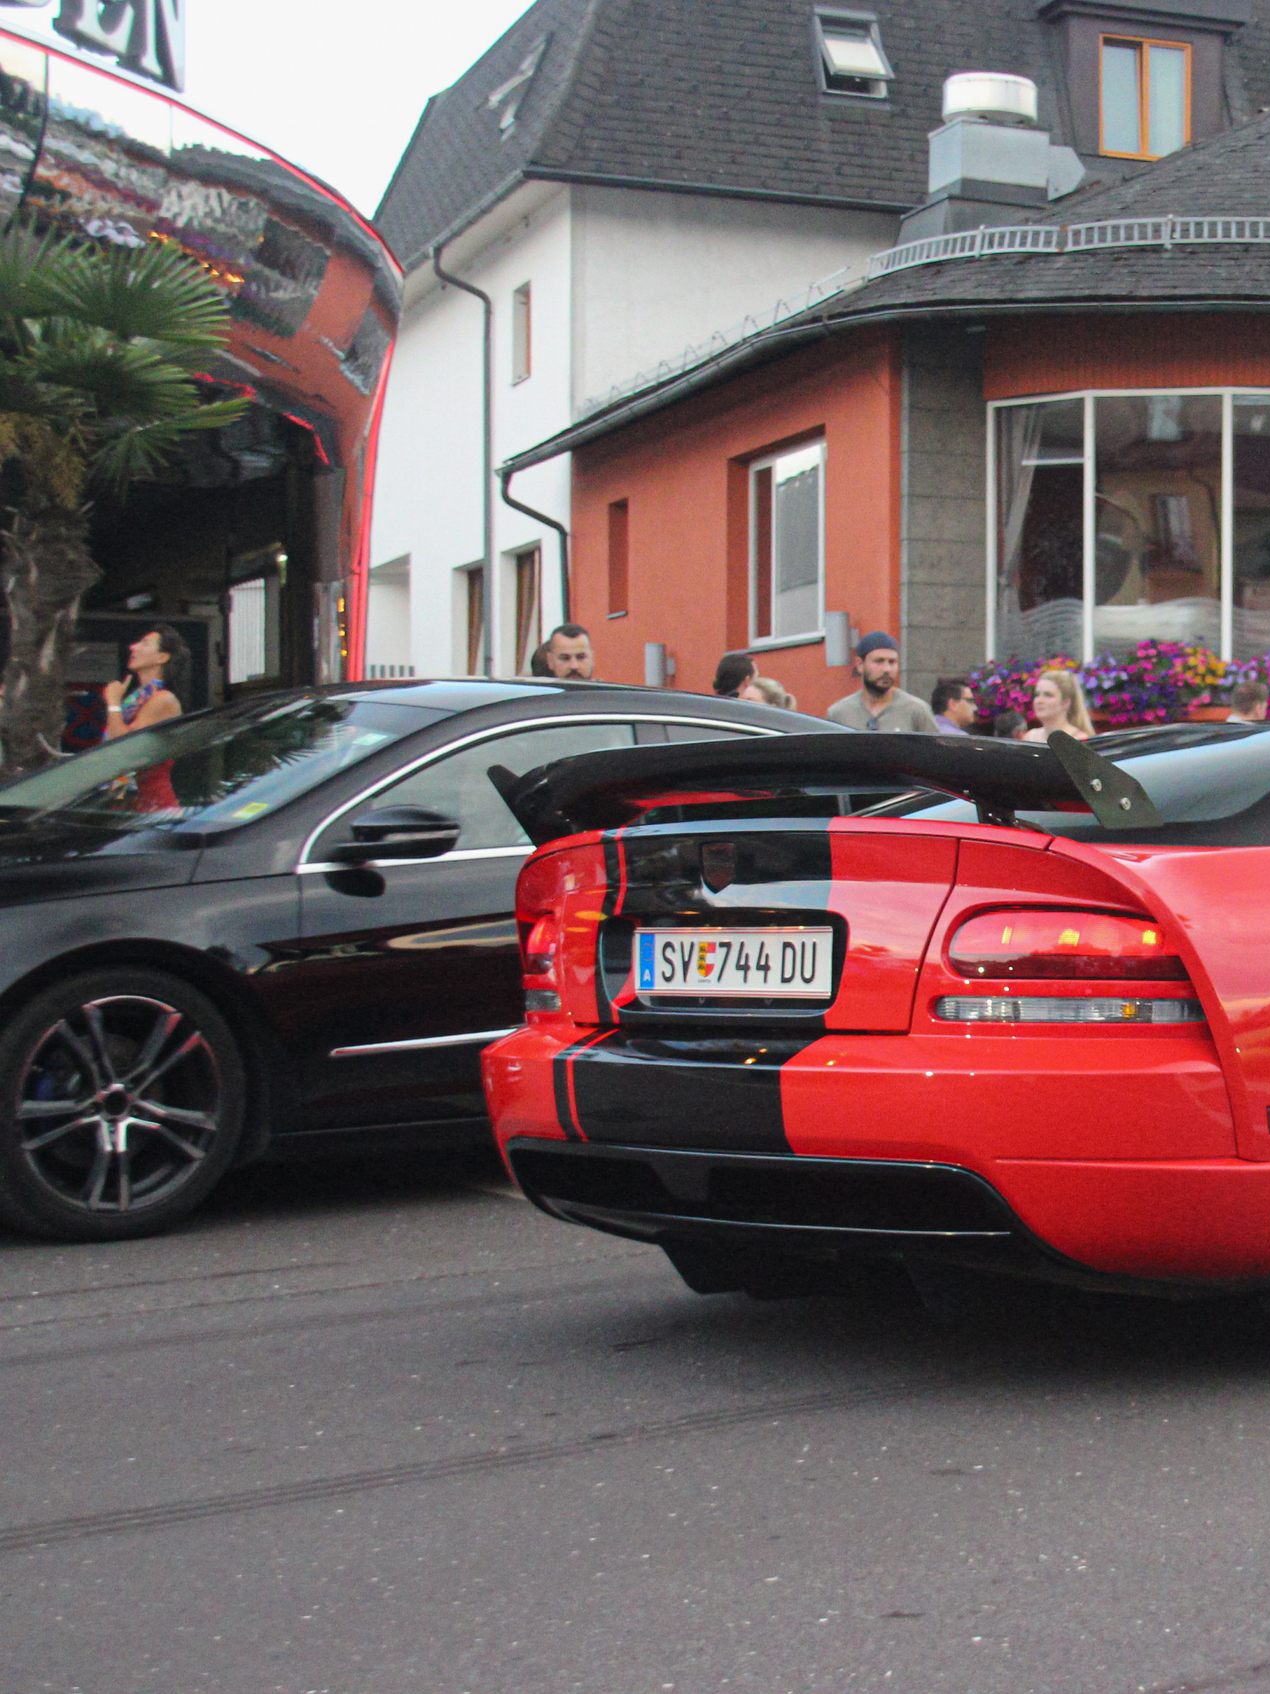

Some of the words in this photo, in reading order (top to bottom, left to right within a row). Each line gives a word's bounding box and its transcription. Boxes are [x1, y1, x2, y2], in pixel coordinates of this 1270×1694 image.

[643, 969, 651, 981] A
[661, 941, 694, 983] SV
[717, 941, 771, 983] 744
[780, 941, 817, 984] DU
